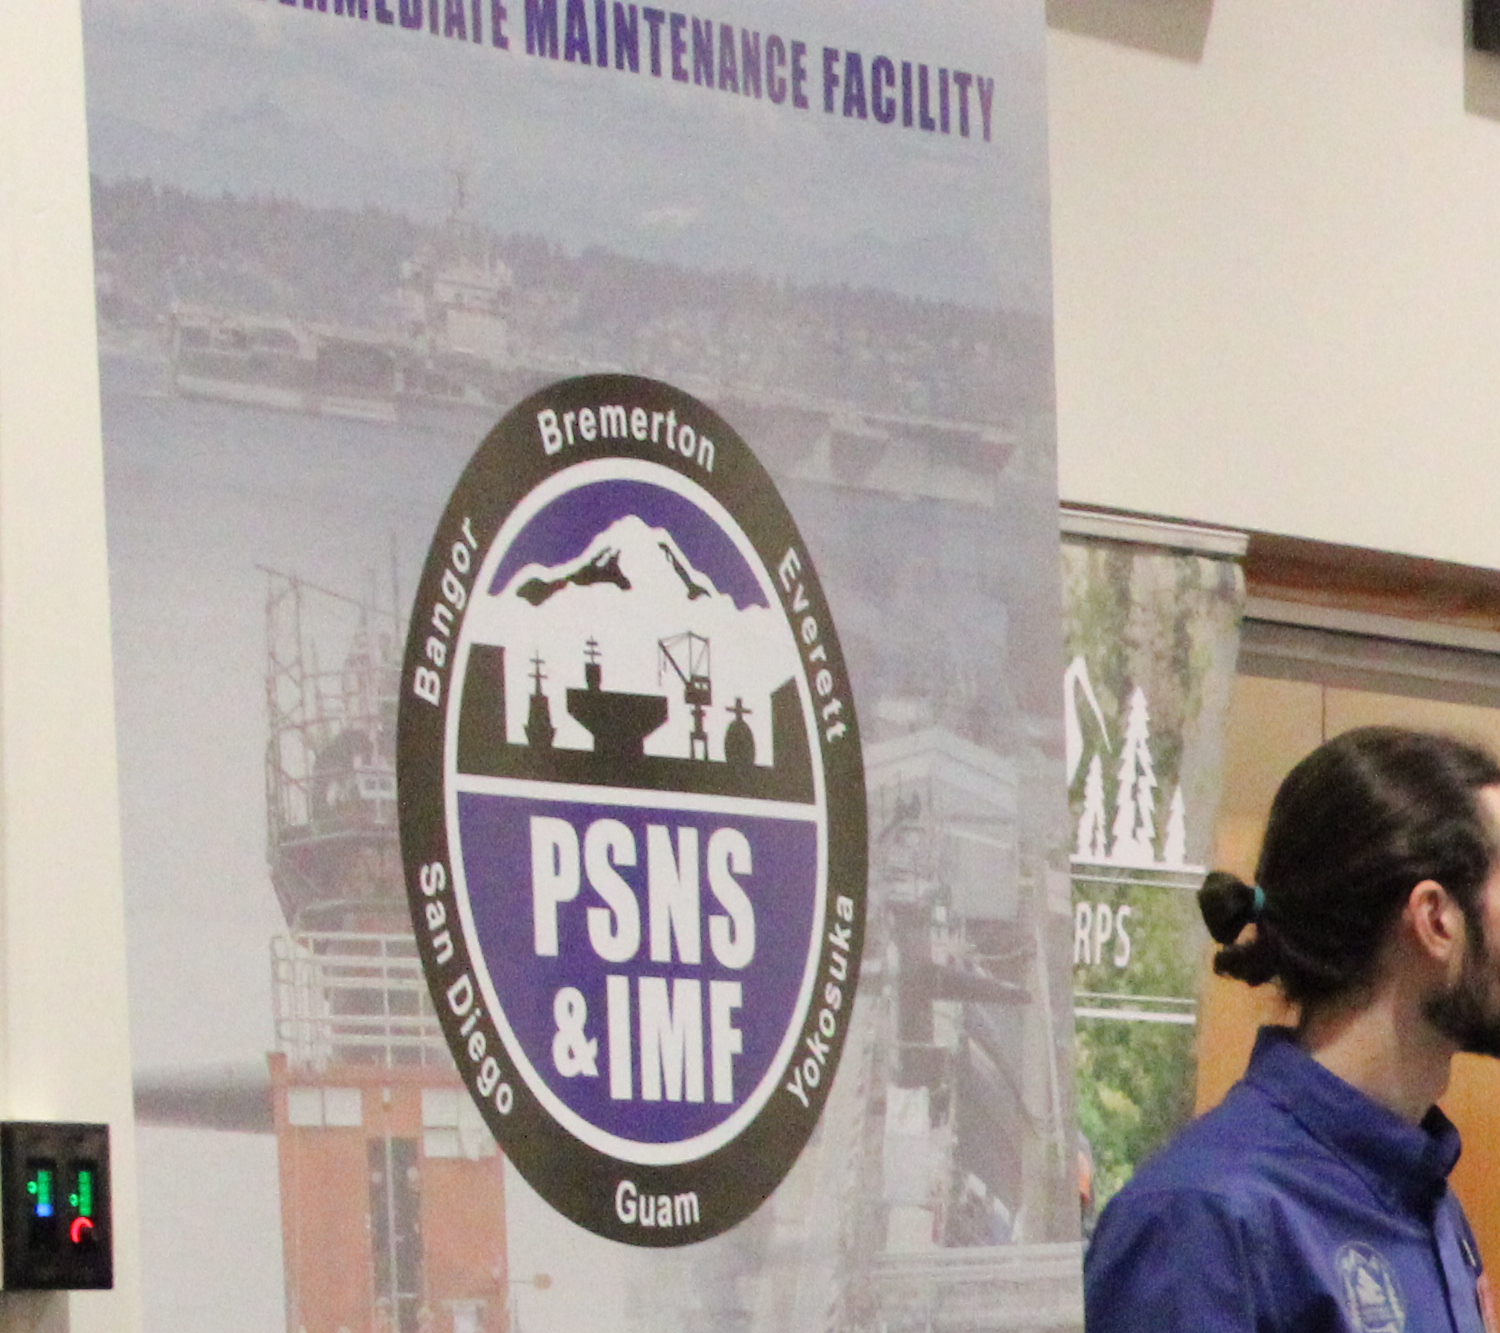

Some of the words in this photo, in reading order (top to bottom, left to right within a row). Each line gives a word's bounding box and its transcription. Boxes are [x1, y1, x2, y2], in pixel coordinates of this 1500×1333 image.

[524, 0, 809, 110] MAINTENANCE
[823, 47, 996, 143] FACILITY
[537, 403, 716, 473] Bremerton
[412, 516, 481, 707] Bangor
[778, 546, 847, 746] Everett
[529, 815, 757, 970] PSNS
[419, 861, 456, 966] San
[446, 973, 515, 1115] Diego
[551, 986, 599, 1078] &
[606, 974, 744, 1105] IMF
[786, 895, 855, 1108] Yokosuka
[614, 1180, 701, 1229] Guam
